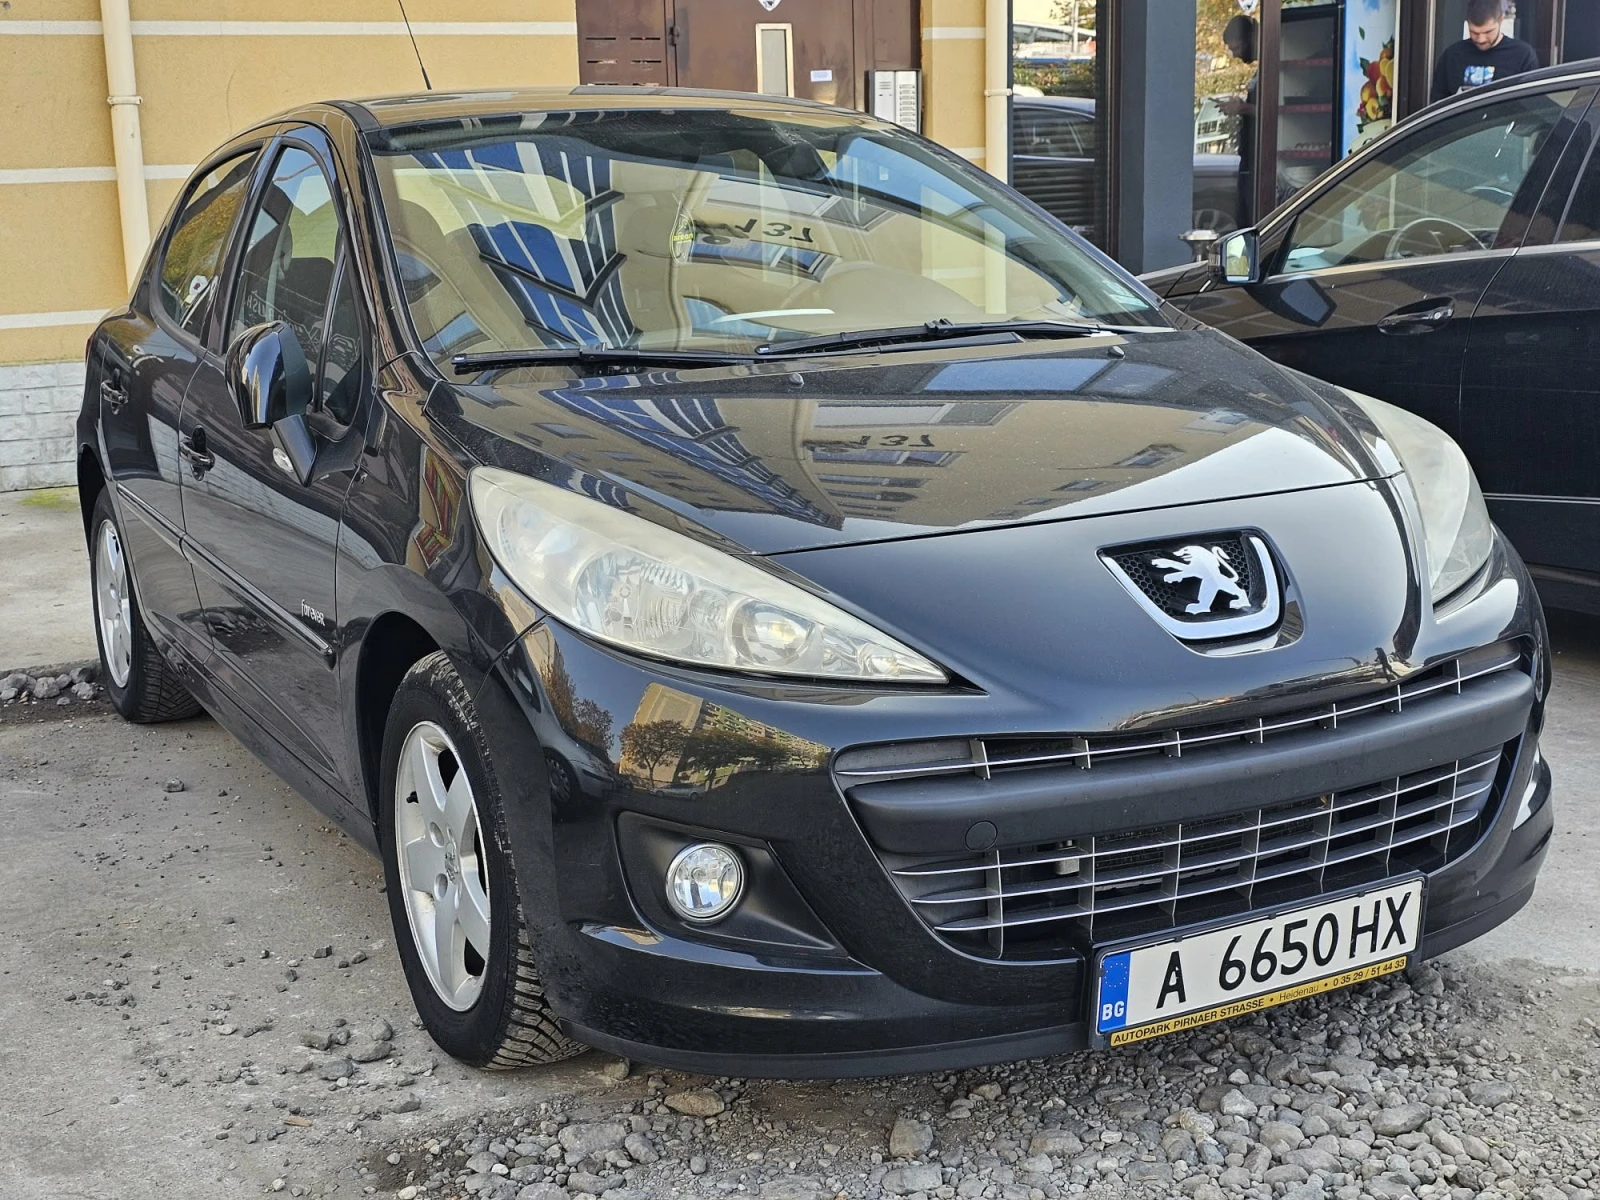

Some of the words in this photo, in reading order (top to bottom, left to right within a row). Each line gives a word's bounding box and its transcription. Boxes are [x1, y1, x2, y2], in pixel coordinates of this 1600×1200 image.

[1155, 950, 1187, 1010] A
[1218, 912, 1339, 992] 6650
[1349, 891, 1413, 960] HX
[1101, 1000, 1125, 1021] BG
[1113, 1023, 1172, 1044] AUTOPARK
[1173, 1010, 1218, 1030] PIRNAER
[1219, 997, 1265, 1018] STRASSE
[1279, 982, 1319, 1001] Heidenau
[1332, 977, 1339, 987] 0
[1340, 974, 1351, 985] 35
[1353, 971, 1364, 982] 29
[1371, 966, 1381, 977] 51
[1383, 962, 1393, 972] 44
[1395, 958, 1405, 969] 33
